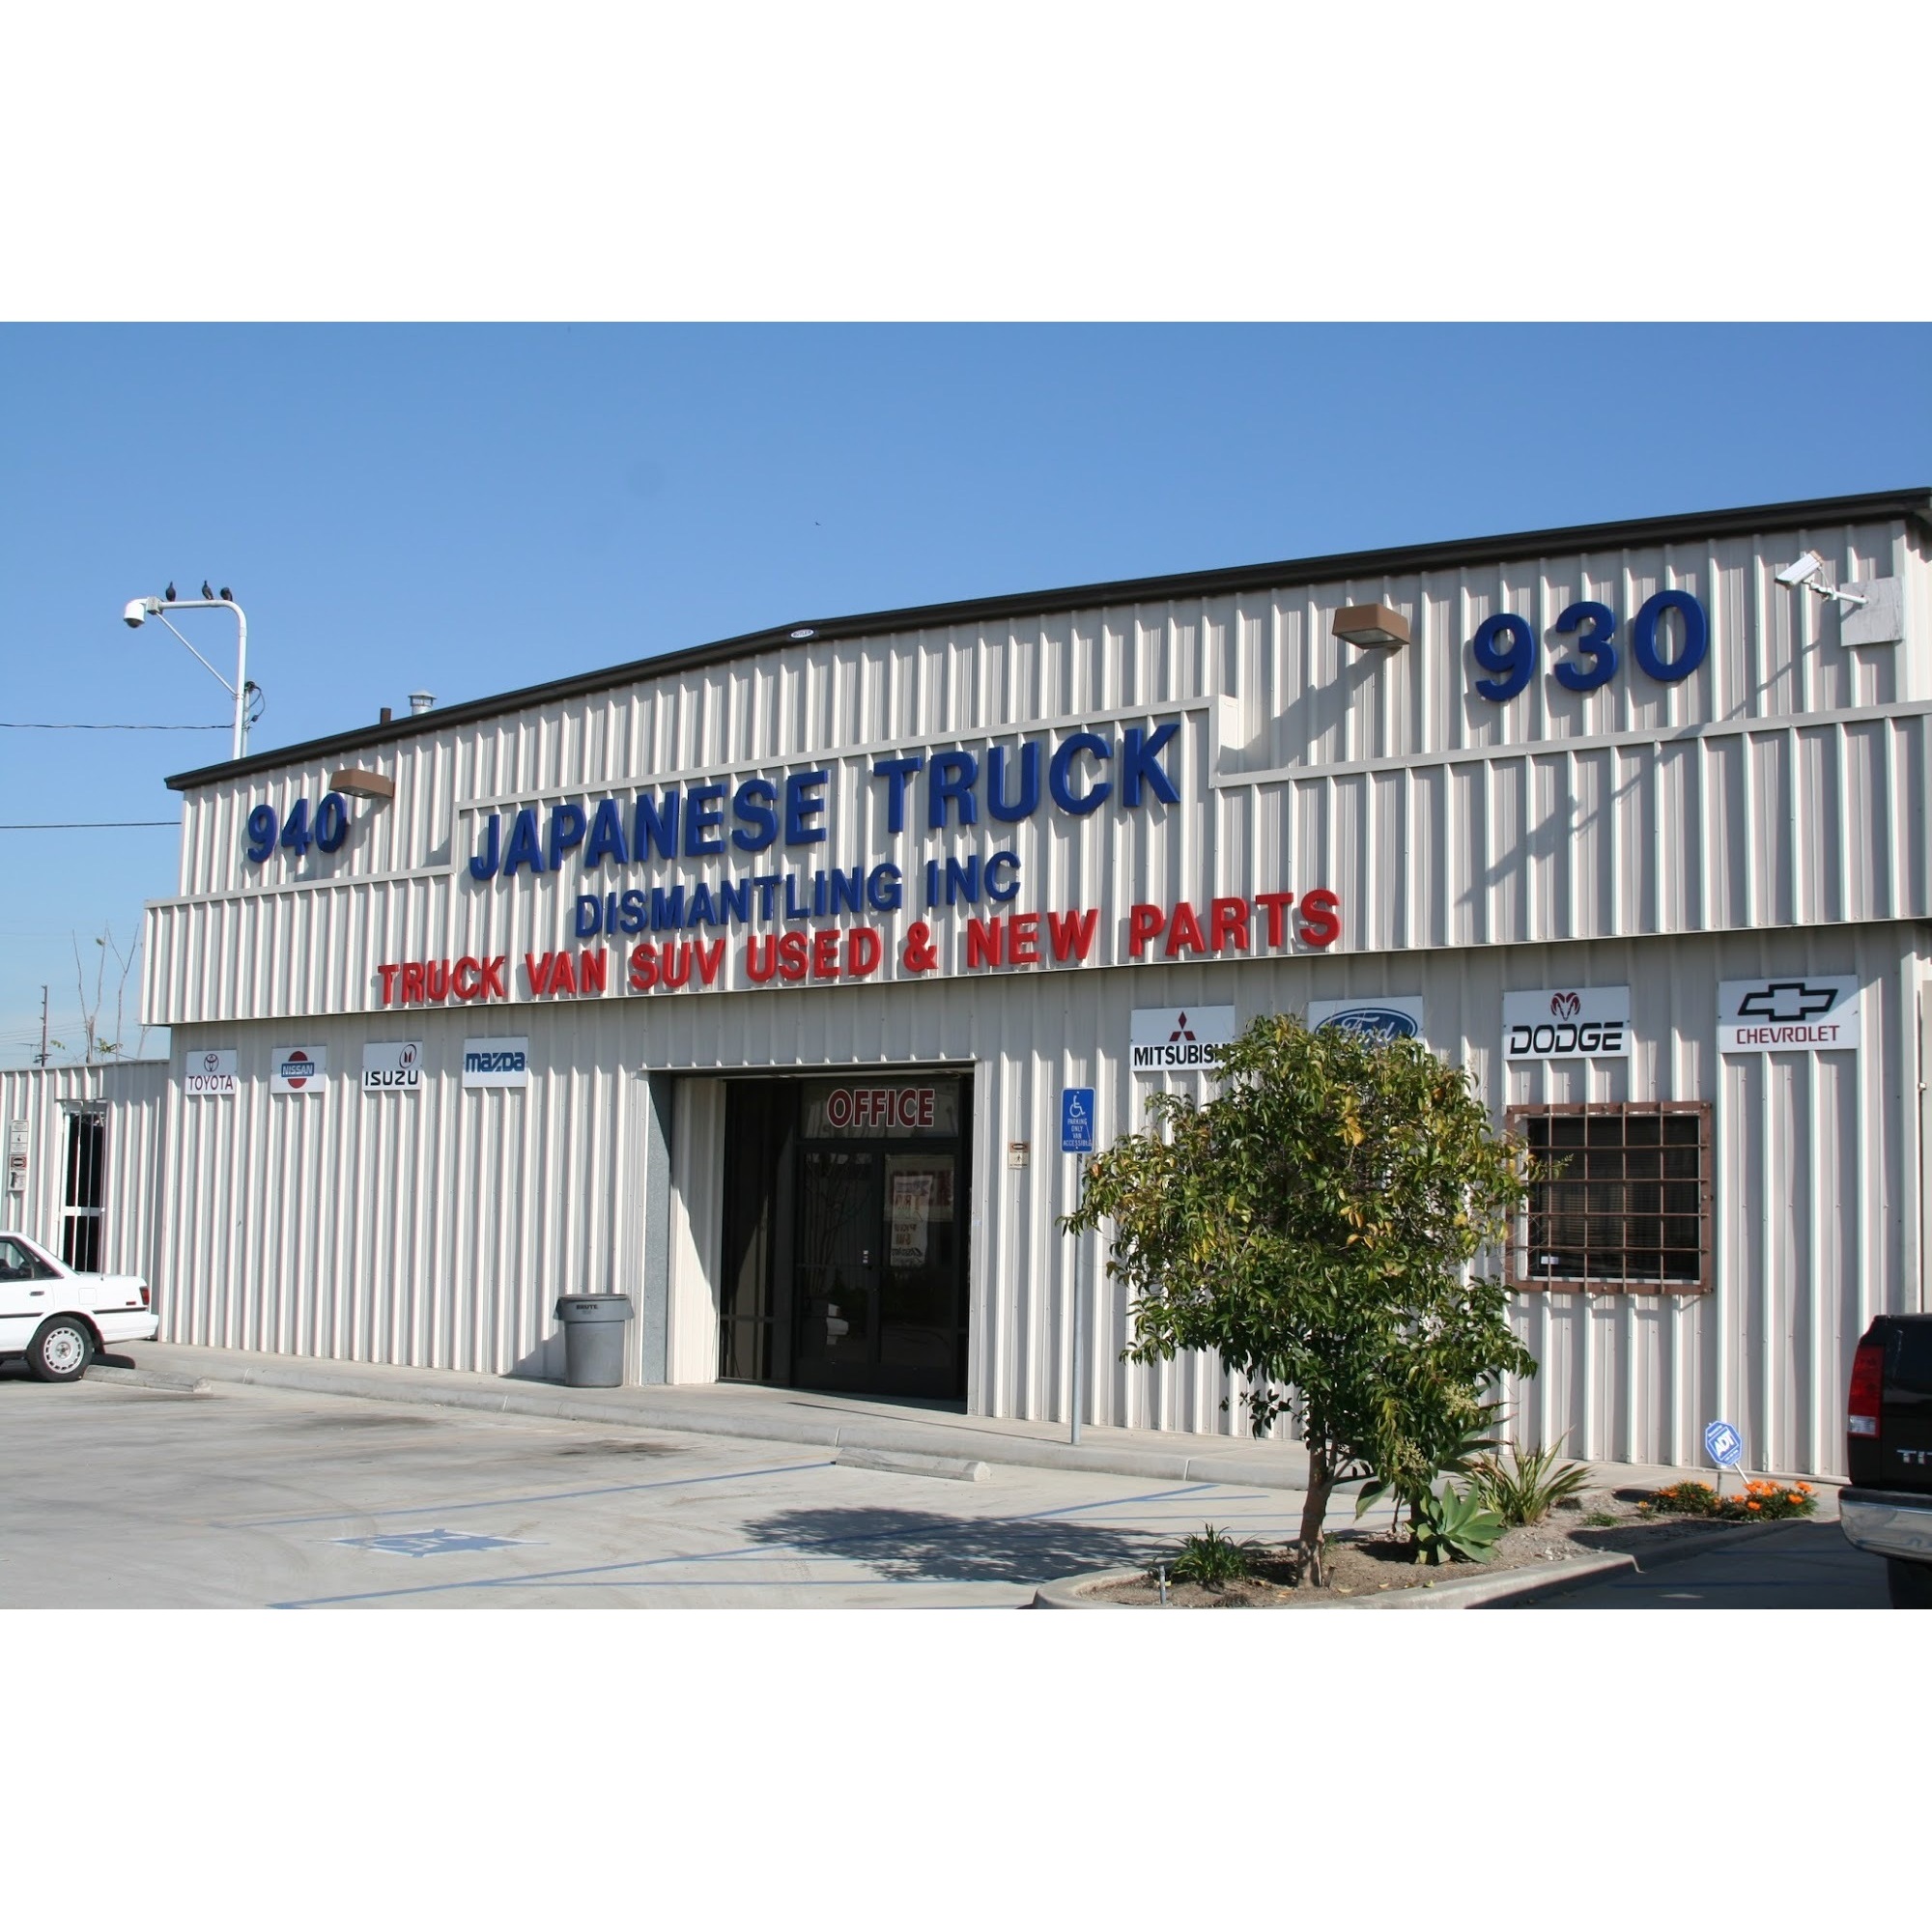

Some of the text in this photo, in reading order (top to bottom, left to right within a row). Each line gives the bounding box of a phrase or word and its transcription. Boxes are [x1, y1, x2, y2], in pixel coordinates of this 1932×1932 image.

[1473, 589, 1710, 702] 930
[469, 723, 1181, 881] JAPANESE TRUCK
[247, 792, 349, 864] 940
[575, 851, 1021, 938] DISMANTLING INC
[377, 889, 1342, 1005] TRUCK VAN SUV USED & NEW PARTS
[1510, 1021, 1624, 1054] DODGE
[1736, 1025, 1840, 1045] CHEVROLET
[1134, 1042, 1232, 1065] MITSUBIS
[188, 1074, 234, 1091] TOYOTA
[282, 1064, 314, 1075] NISSAN
[364, 1069, 419, 1086] ISUZU
[827, 1088, 935, 1128] OFFICE
[1714, 1430, 1735, 1457] ADT
[1896, 1449, 1932, 1464] TI
